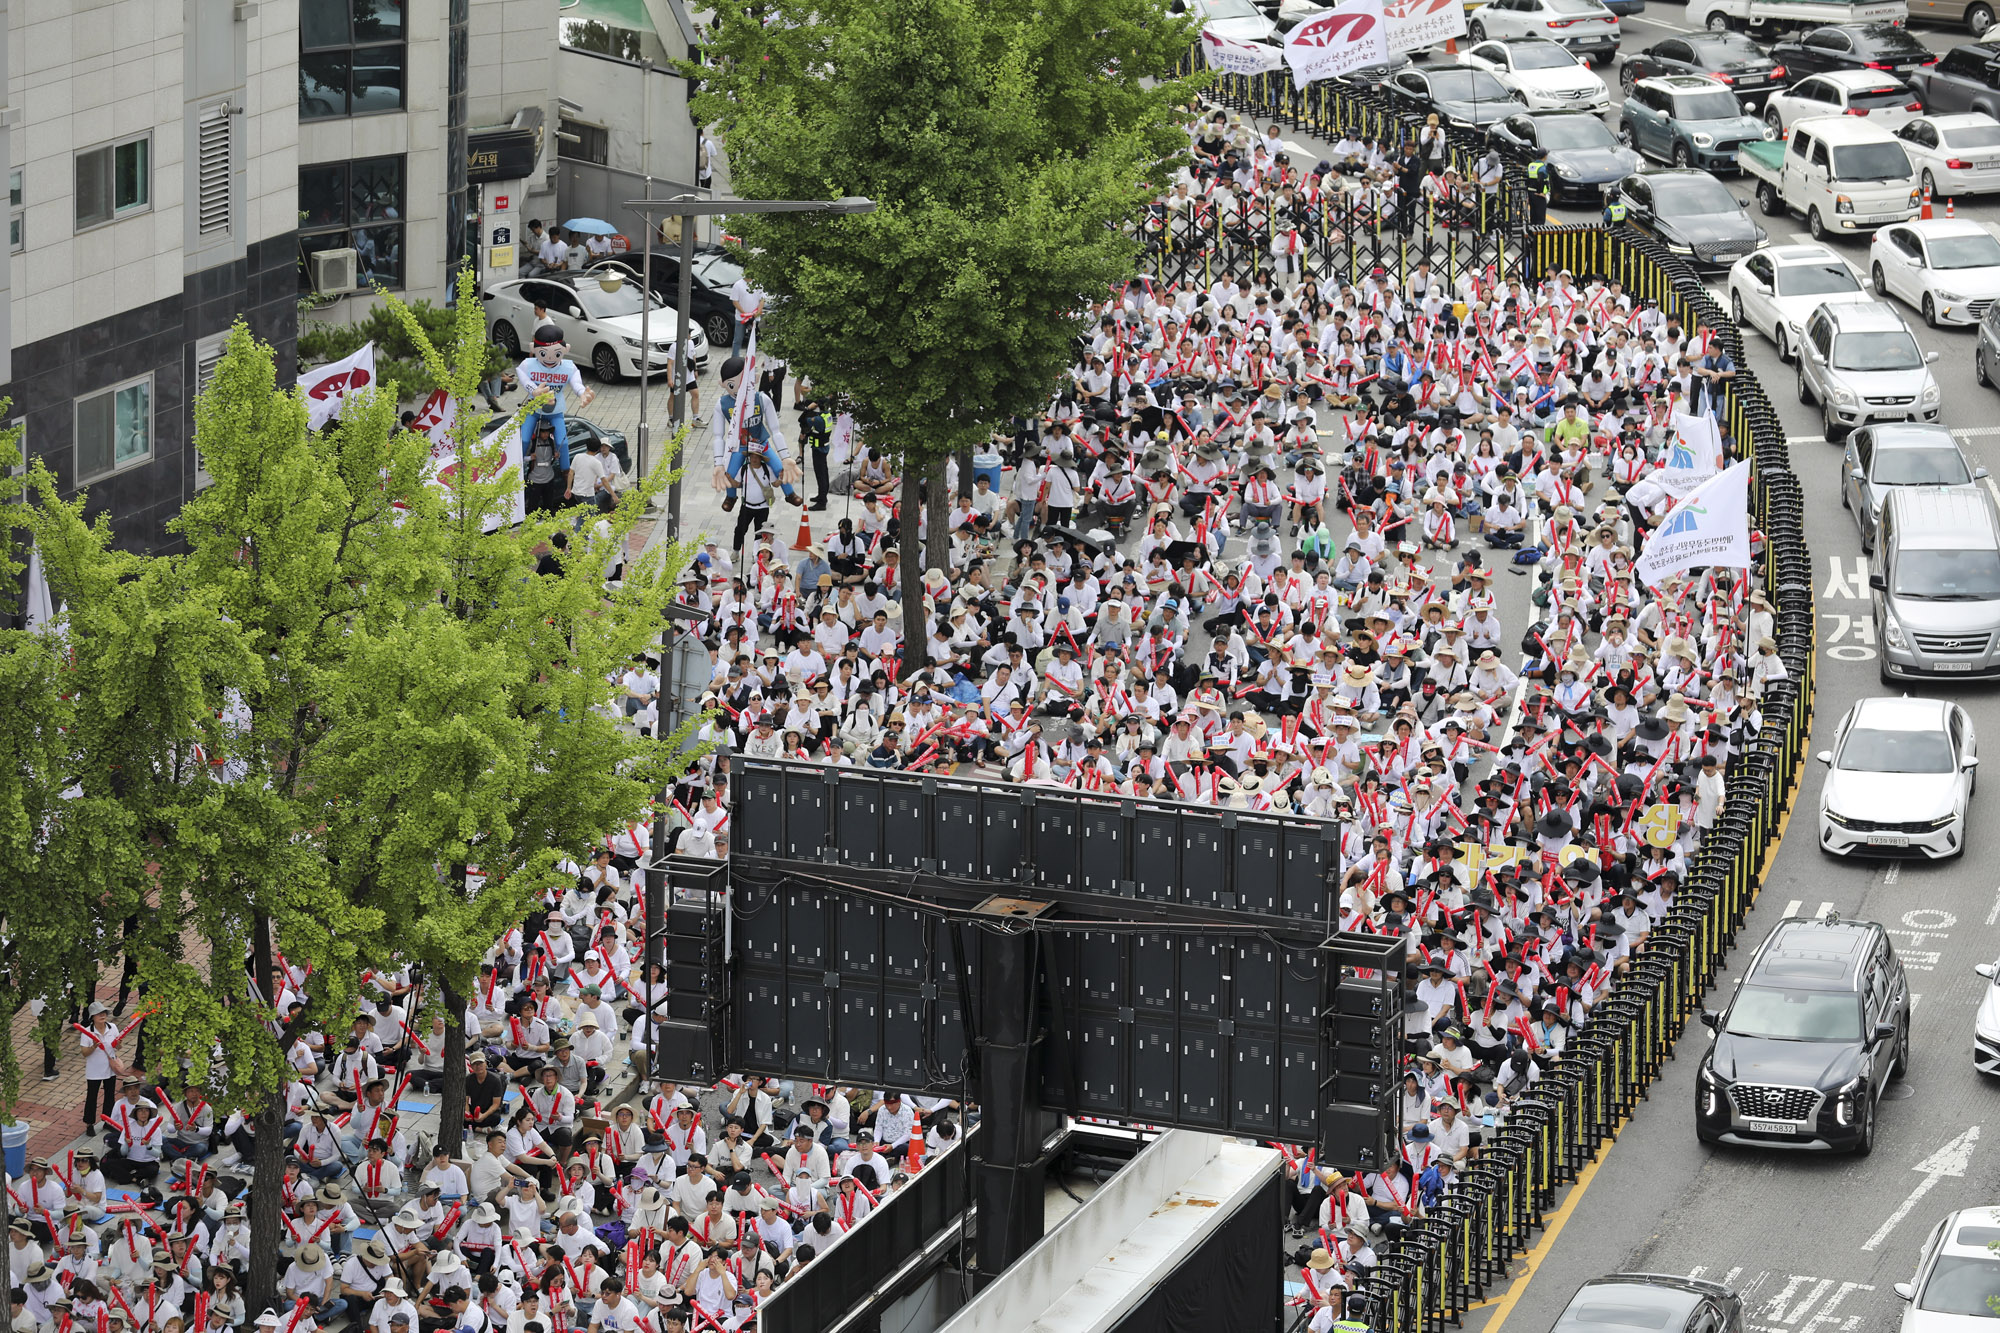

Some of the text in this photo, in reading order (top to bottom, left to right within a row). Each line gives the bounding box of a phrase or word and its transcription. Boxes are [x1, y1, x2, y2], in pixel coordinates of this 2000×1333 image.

[478, 153, 498, 166] 타워
[497, 235, 506, 244] 96
[530, 372, 569, 384] 31만3천원
[1822, 556, 1871, 599] 서
[1821, 614, 1877, 661] 경
[755, 744, 774, 753] YES
[1639, 804, 1682, 848] 상
